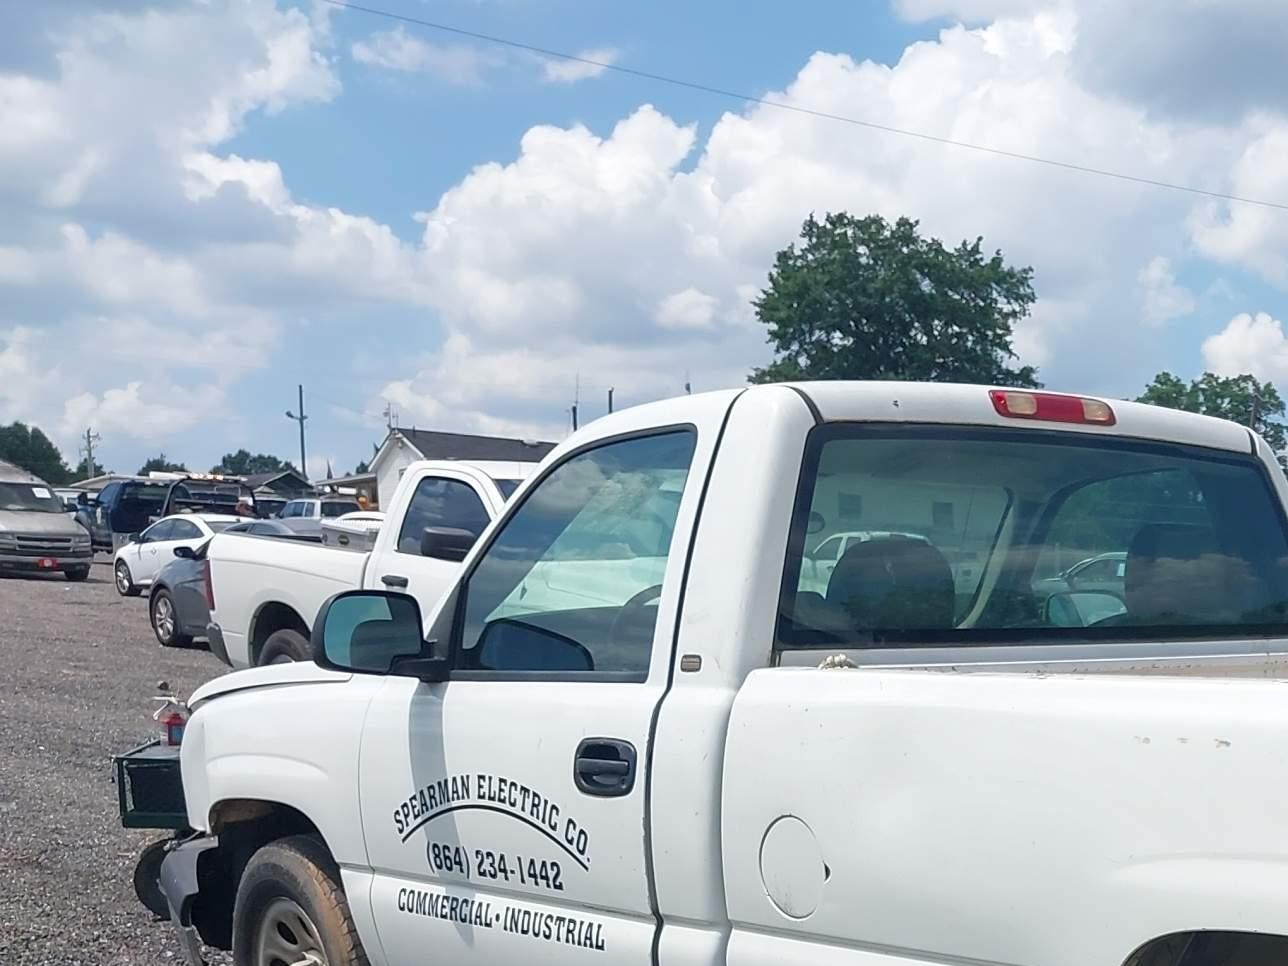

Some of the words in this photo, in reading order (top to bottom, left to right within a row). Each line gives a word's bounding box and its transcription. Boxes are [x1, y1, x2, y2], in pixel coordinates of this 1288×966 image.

[393, 774, 471, 834] SPEARMAN
[476, 774, 560, 831] ELECTRIC
[426, 839, 471, 880] (864)
[475, 849, 564, 891] 234-1442
